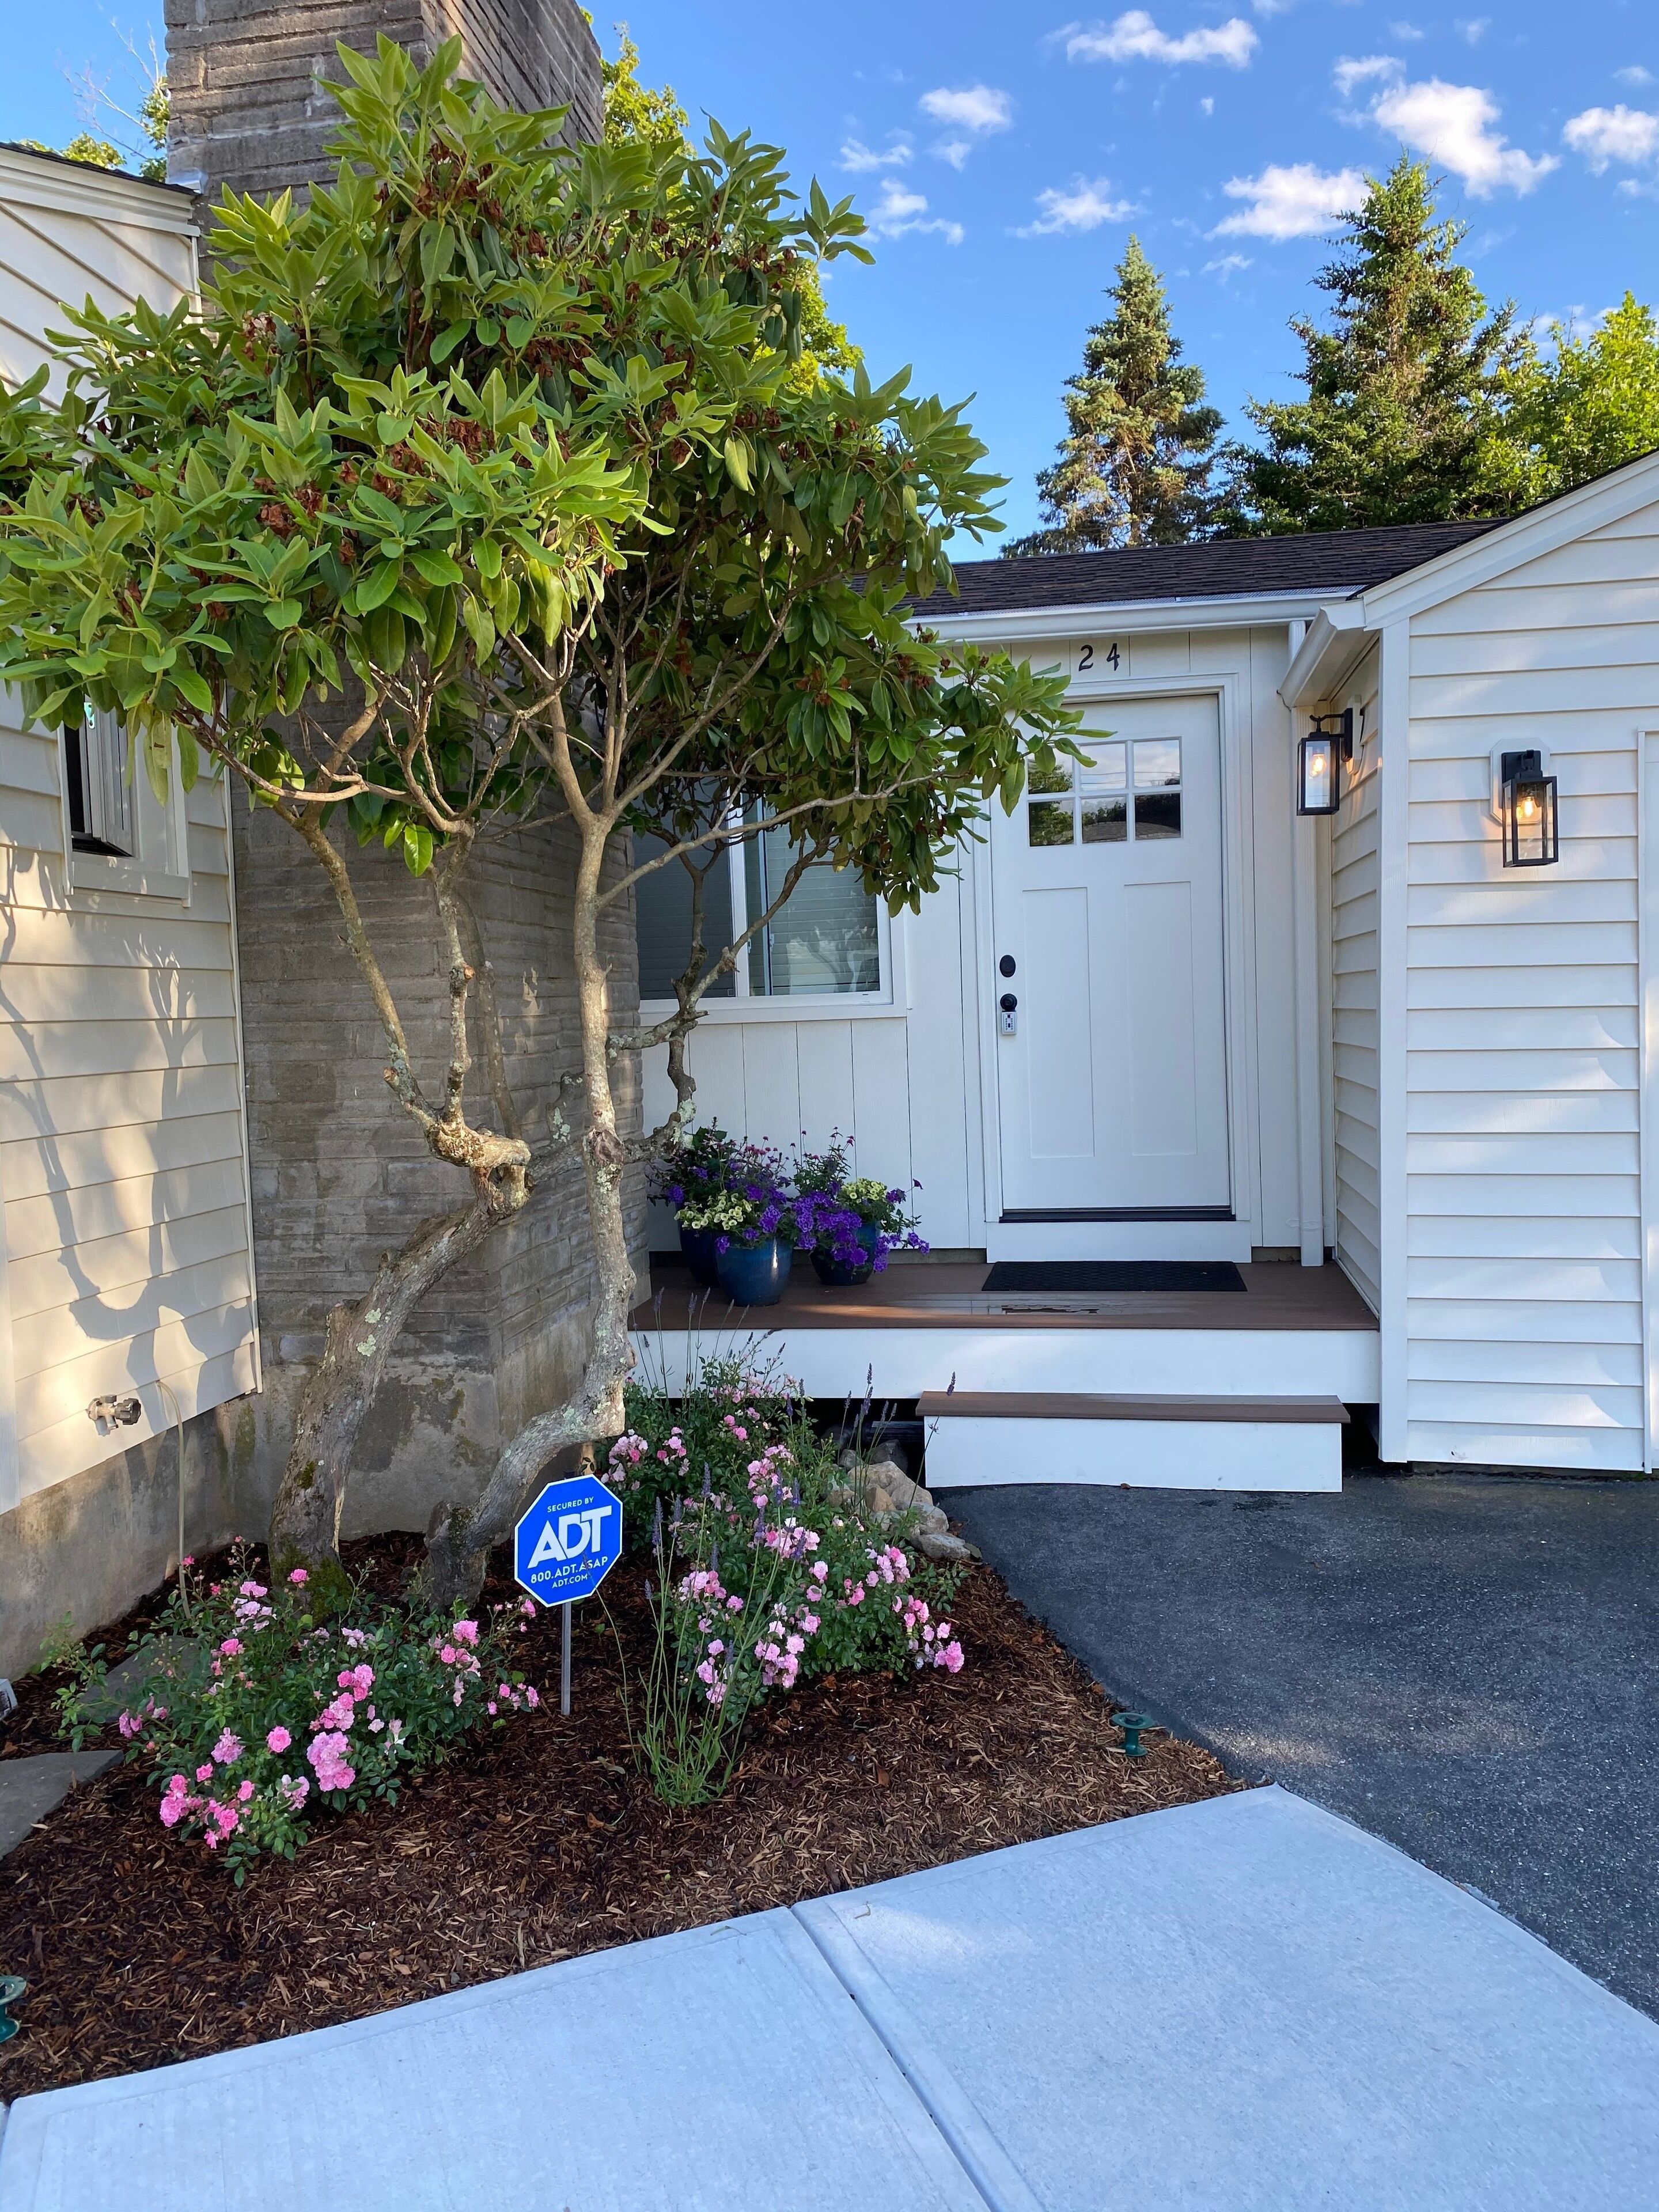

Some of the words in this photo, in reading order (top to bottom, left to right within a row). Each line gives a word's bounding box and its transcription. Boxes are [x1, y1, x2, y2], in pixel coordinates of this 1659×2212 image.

[1078, 642, 1120, 672] 24
[547, 1499, 582, 1513] SECURED
[584, 1496, 594, 1505] BY
[527, 1505, 612, 1569] ADT
[531, 1556, 608, 1584] 800.ADT.ASAP
[551, 1573, 588, 1589] ADT.COM
